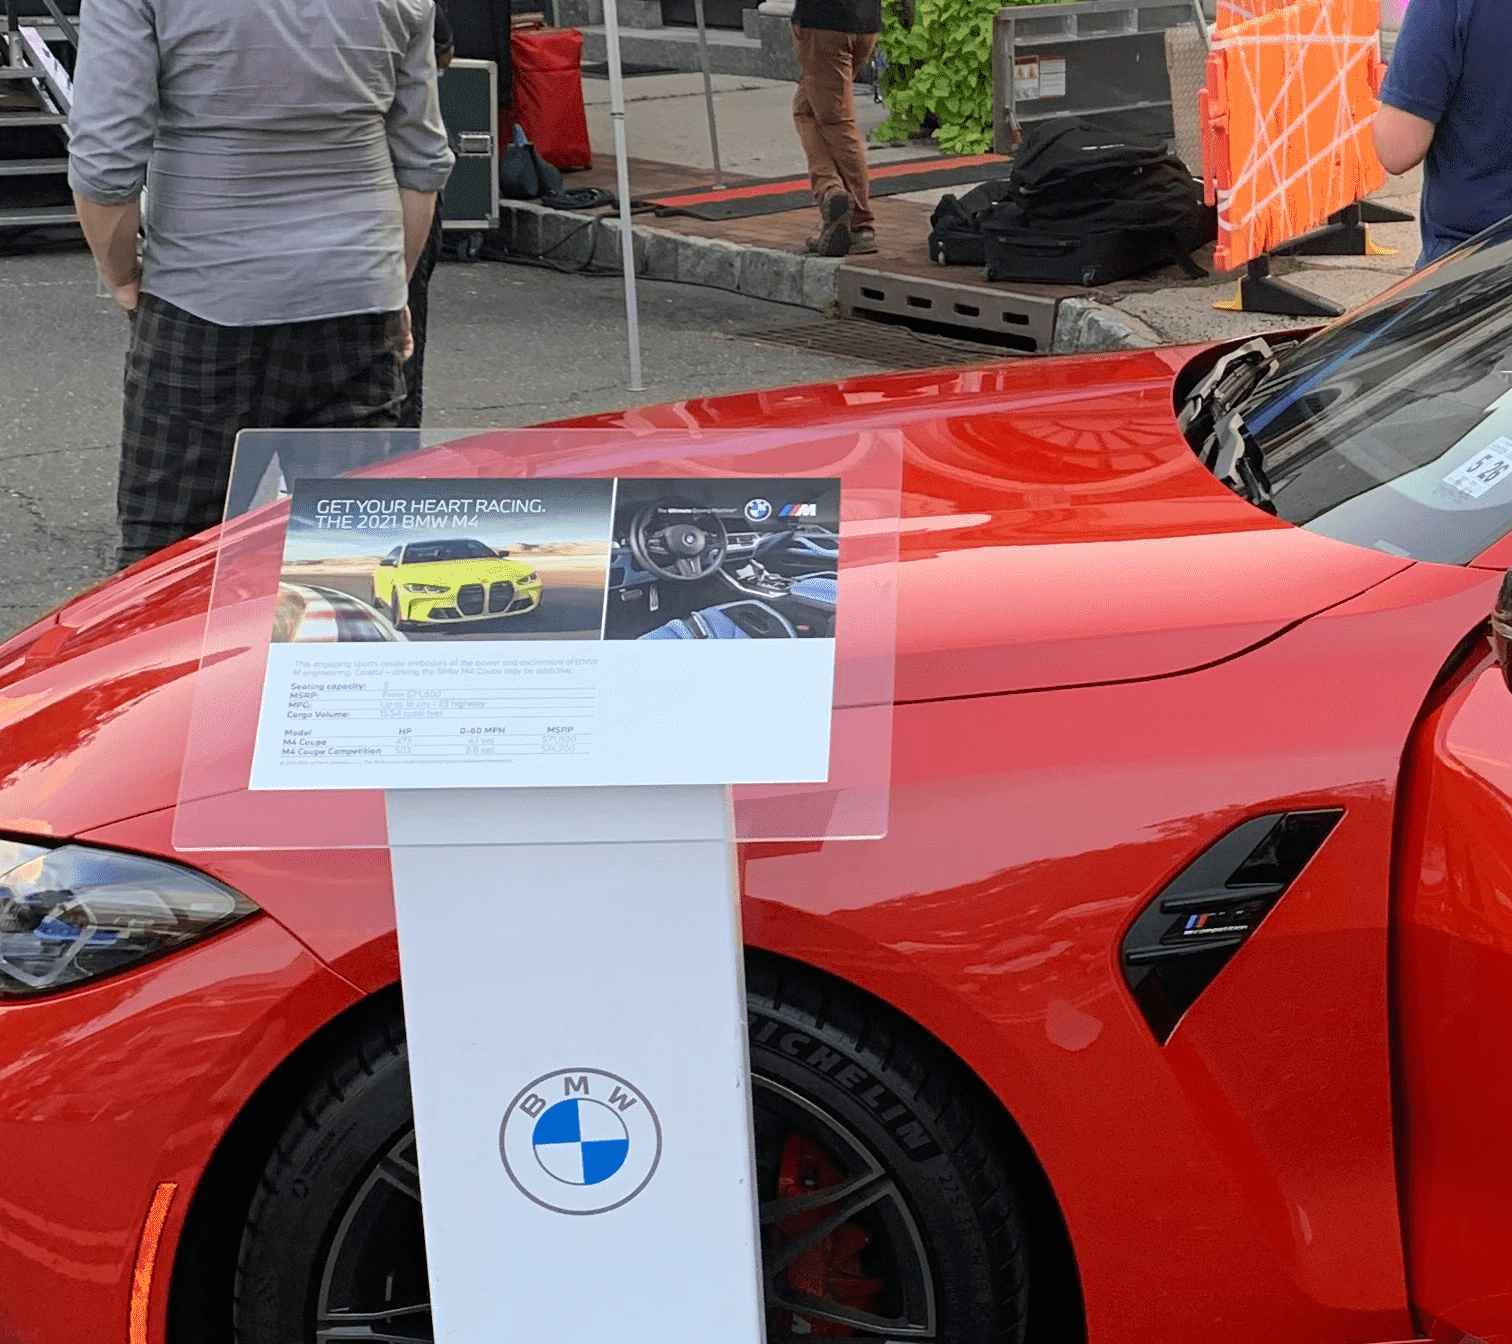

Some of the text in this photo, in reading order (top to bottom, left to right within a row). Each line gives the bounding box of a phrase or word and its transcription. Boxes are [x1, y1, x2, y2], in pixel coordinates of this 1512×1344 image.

[317, 499, 546, 514] GET YOUR HEART RACING.
[315, 515, 480, 529] THE 2021 BMW M4
[519, 1075, 638, 1119] BMW
[750, 1018, 932, 1149] ICHELIN
